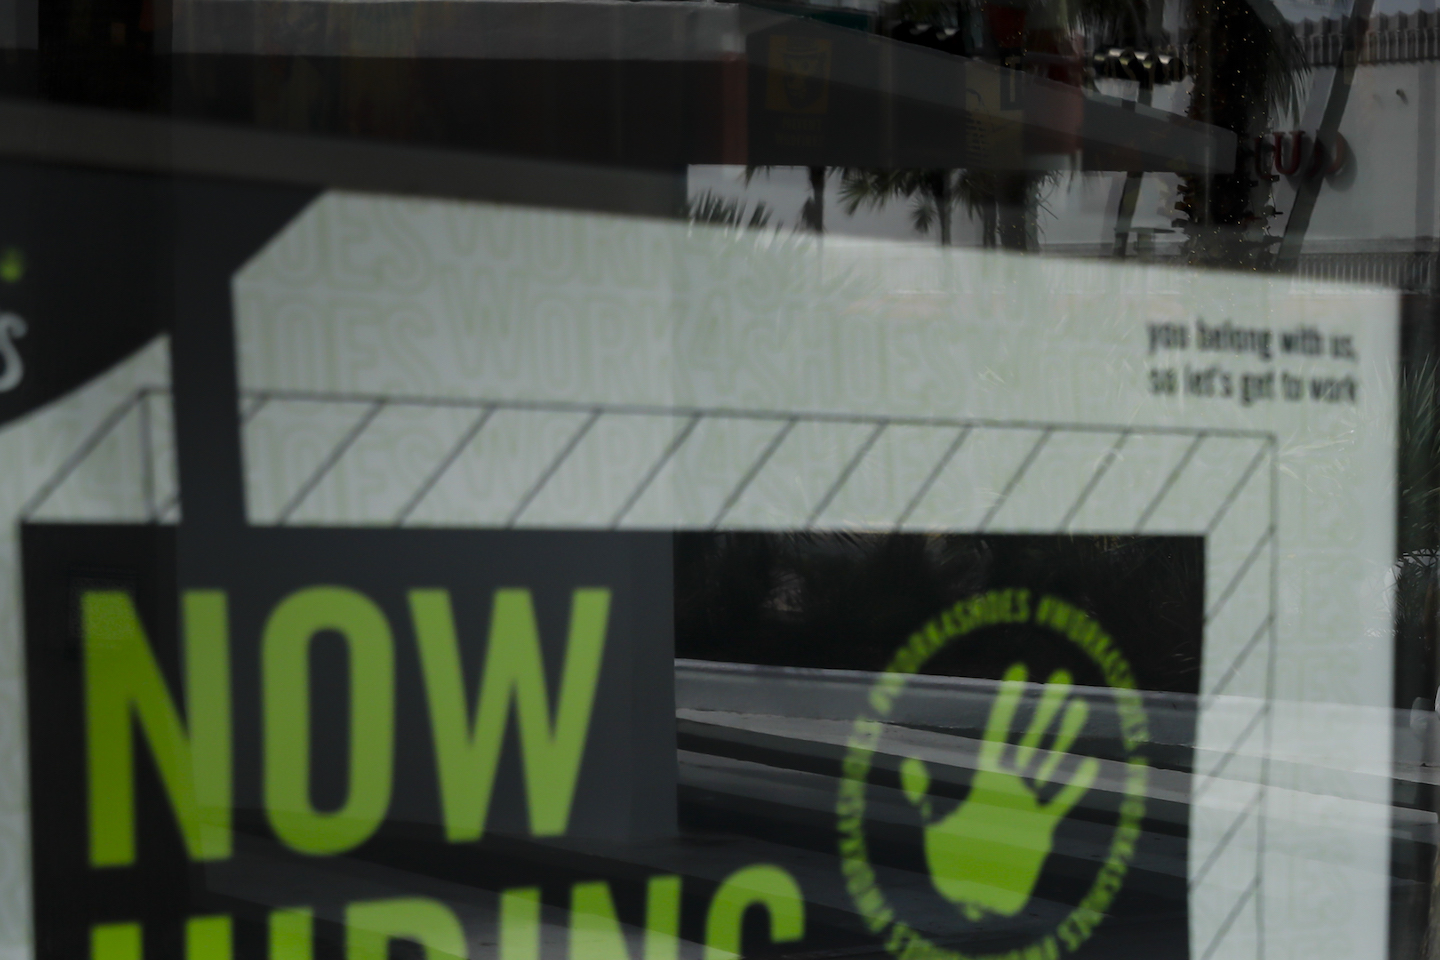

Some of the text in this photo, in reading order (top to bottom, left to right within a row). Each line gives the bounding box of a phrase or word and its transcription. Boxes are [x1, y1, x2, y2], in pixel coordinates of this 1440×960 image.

[1147, 322, 1188, 356] you
[1197, 318, 1272, 361] belong
[1280, 325, 1323, 357] with
[1150, 365, 1357, 406] so let's get to work
[81, 585, 611, 869] NOW
